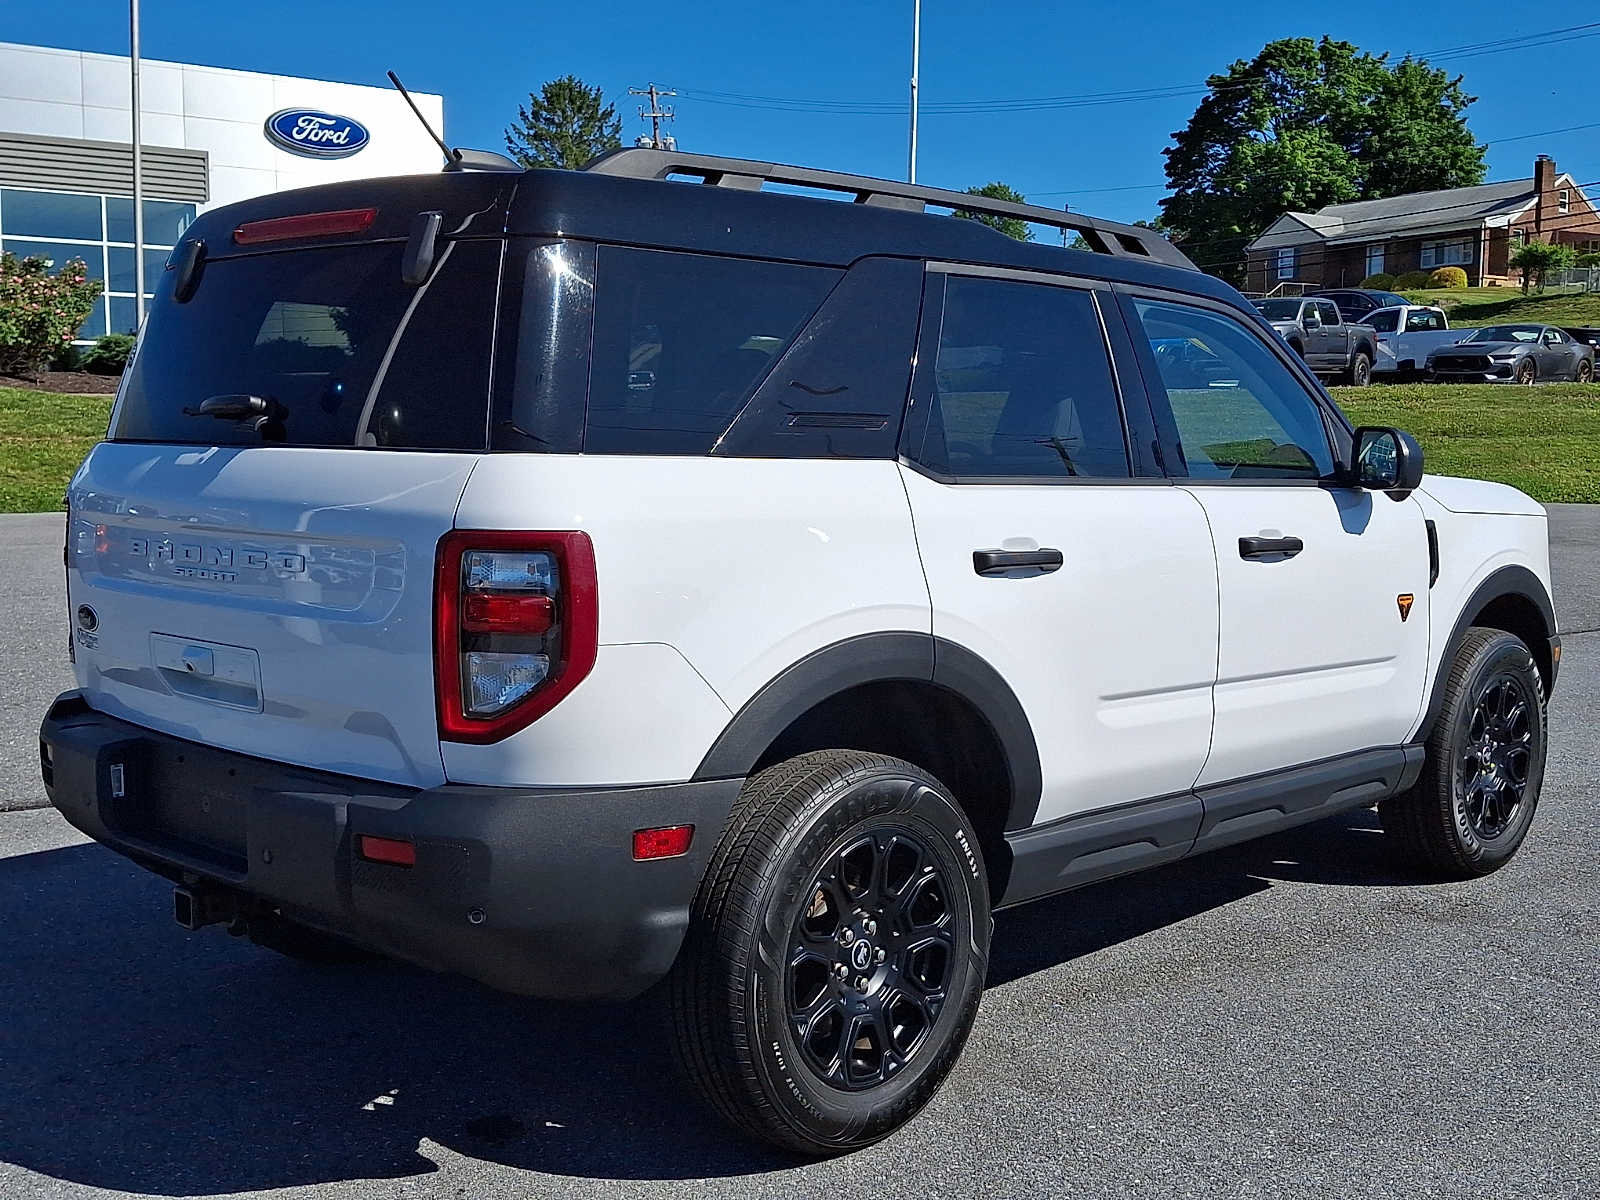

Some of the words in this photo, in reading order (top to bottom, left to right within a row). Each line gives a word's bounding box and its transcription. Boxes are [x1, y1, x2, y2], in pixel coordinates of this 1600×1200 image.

[292, 115, 351, 145] Ford
[129, 537, 306, 574] BRONCO
[173, 565, 239, 582] SPORT
[954, 828, 980, 880] FINESSE
[785, 1078, 825, 1120] 5/65R17
